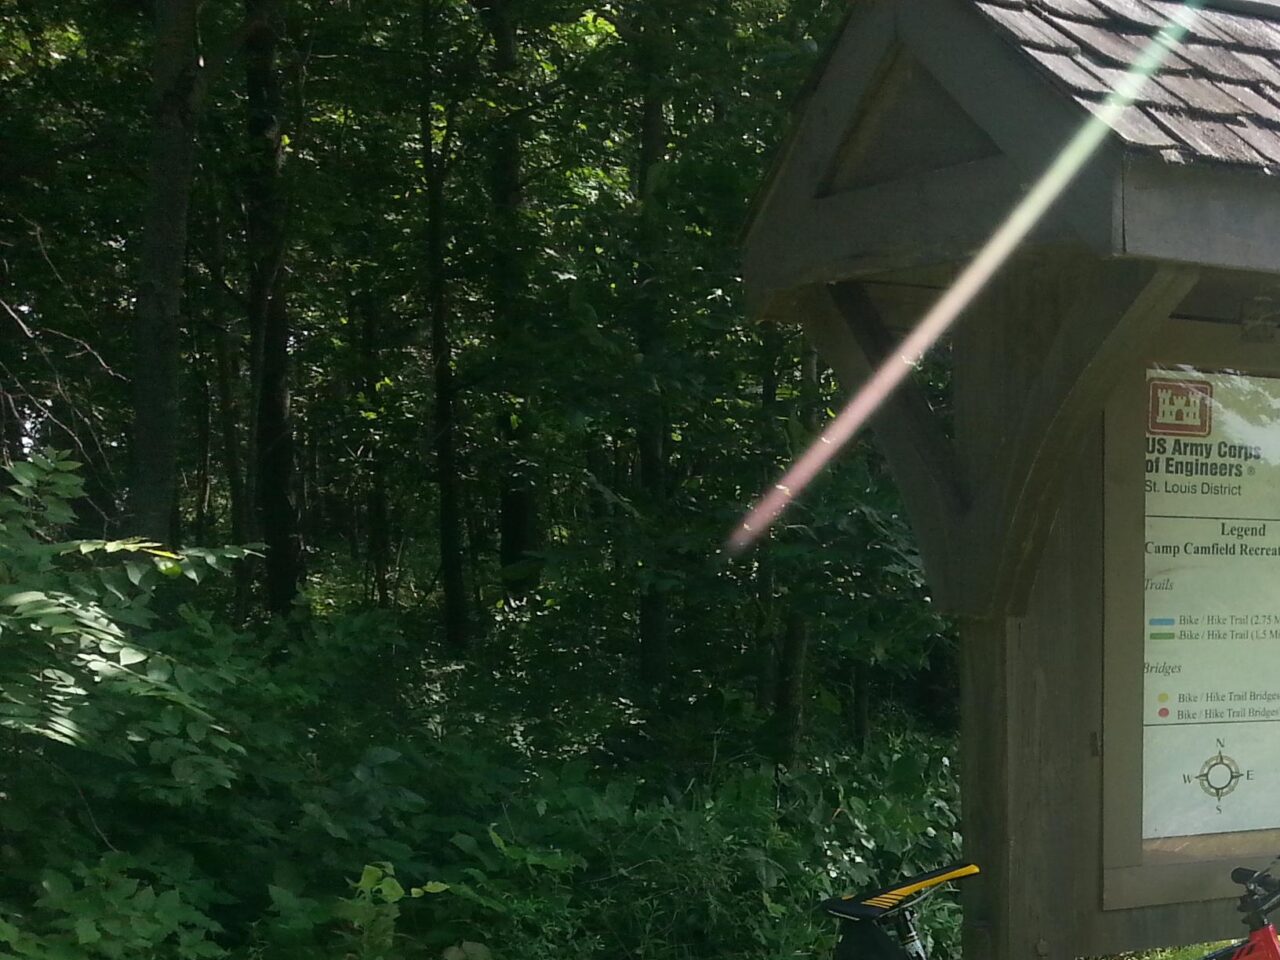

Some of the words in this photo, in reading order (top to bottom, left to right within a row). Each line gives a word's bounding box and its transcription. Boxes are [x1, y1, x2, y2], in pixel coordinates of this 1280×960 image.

[1145, 437, 1167, 455] US
[1171, 438, 1213, 459] Army
[1217, 441, 1262, 461] Corps
[1145, 457, 1160, 473] of
[1165, 457, 1243, 477] Engineers
[1144, 480, 1160, 493] St.
[1164, 481, 1198, 494] Louis
[1201, 482, 1242, 496] District
[1220, 522, 1267, 539] Legend
[1145, 541, 1180, 558] Camp
[1184, 542, 1236, 556] Camfield
[1145, 578, 1174, 591] Trails
[1179, 615, 1199, 625] Bike
[1207, 615, 1228, 625] Hike
[1229, 615, 1249, 625] Trail
[1179, 630, 1200, 640] Bike
[1207, 630, 1228, 640] Hike
[1229, 630, 1249, 640] Trail
[1144, 662, 1182, 676] Bridges
[1178, 693, 1199, 703] Bike
[1206, 692, 1226, 702] Hike
[1228, 691, 1247, 701] Trail
[1249, 691, 1280, 702] Bridges
[1177, 710, 1197, 720] Bike
[1205, 708, 1225, 719] Hike
[1226, 708, 1246, 718] Trail
[1248, 707, 1279, 718] Bridges
[1216, 738, 1226, 748] N
[1182, 774, 1193, 784] W
[1246, 770, 1254, 780] E
[1216, 805, 1222, 815] S
